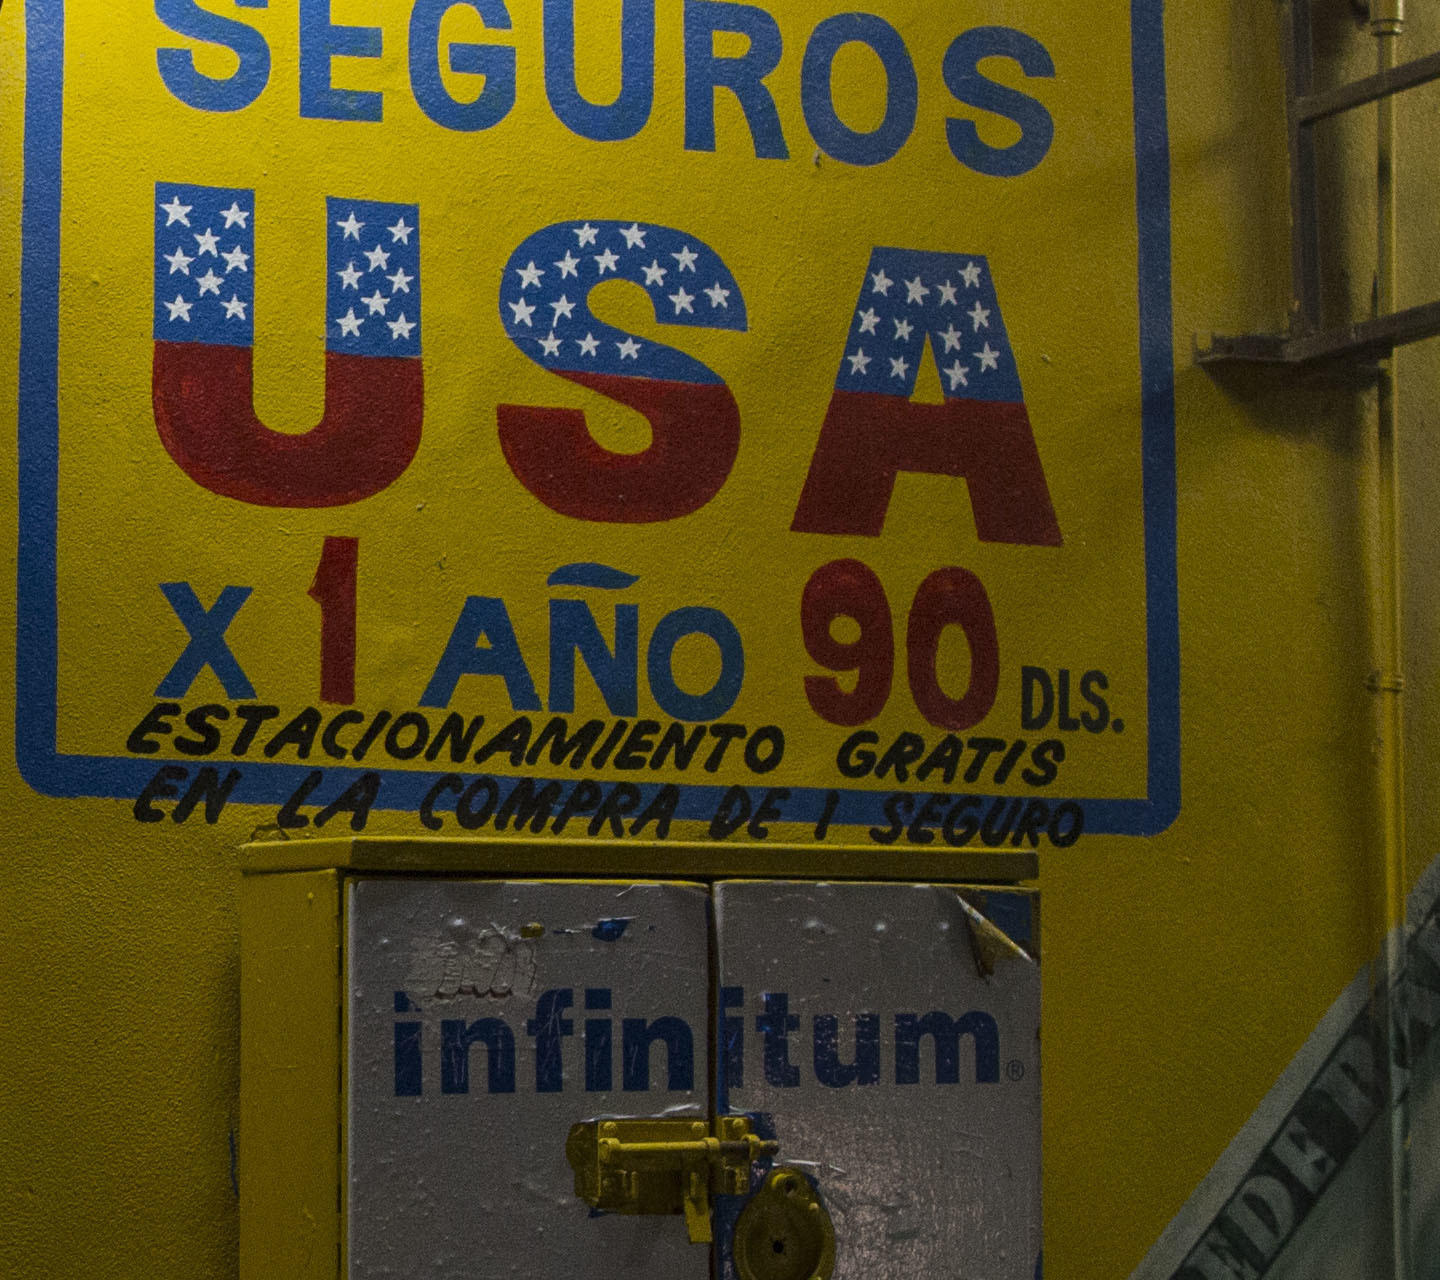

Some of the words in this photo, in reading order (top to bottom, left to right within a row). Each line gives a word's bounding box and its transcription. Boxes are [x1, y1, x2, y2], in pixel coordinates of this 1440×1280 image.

[151, 181, 1064, 548] USA
[156, 580, 257, 702] X
[306, 536, 360, 705] 1
[418, 561, 746, 723] AÑO
[800, 557, 1001, 732] 90
[1021, 664, 1125, 735] DLS.
[126, 703, 786, 776] ESTACIONAMIENTO
[836, 729, 1066, 788] GRATIS
[133, 766, 242, 826] EN
[277, 770, 383, 835] LA
[420, 772, 681, 840] COMPRA
[711, 781, 788, 842] DE
[870, 792, 1087, 848] SEGURO
[393, 987, 1001, 1097] infinitum
